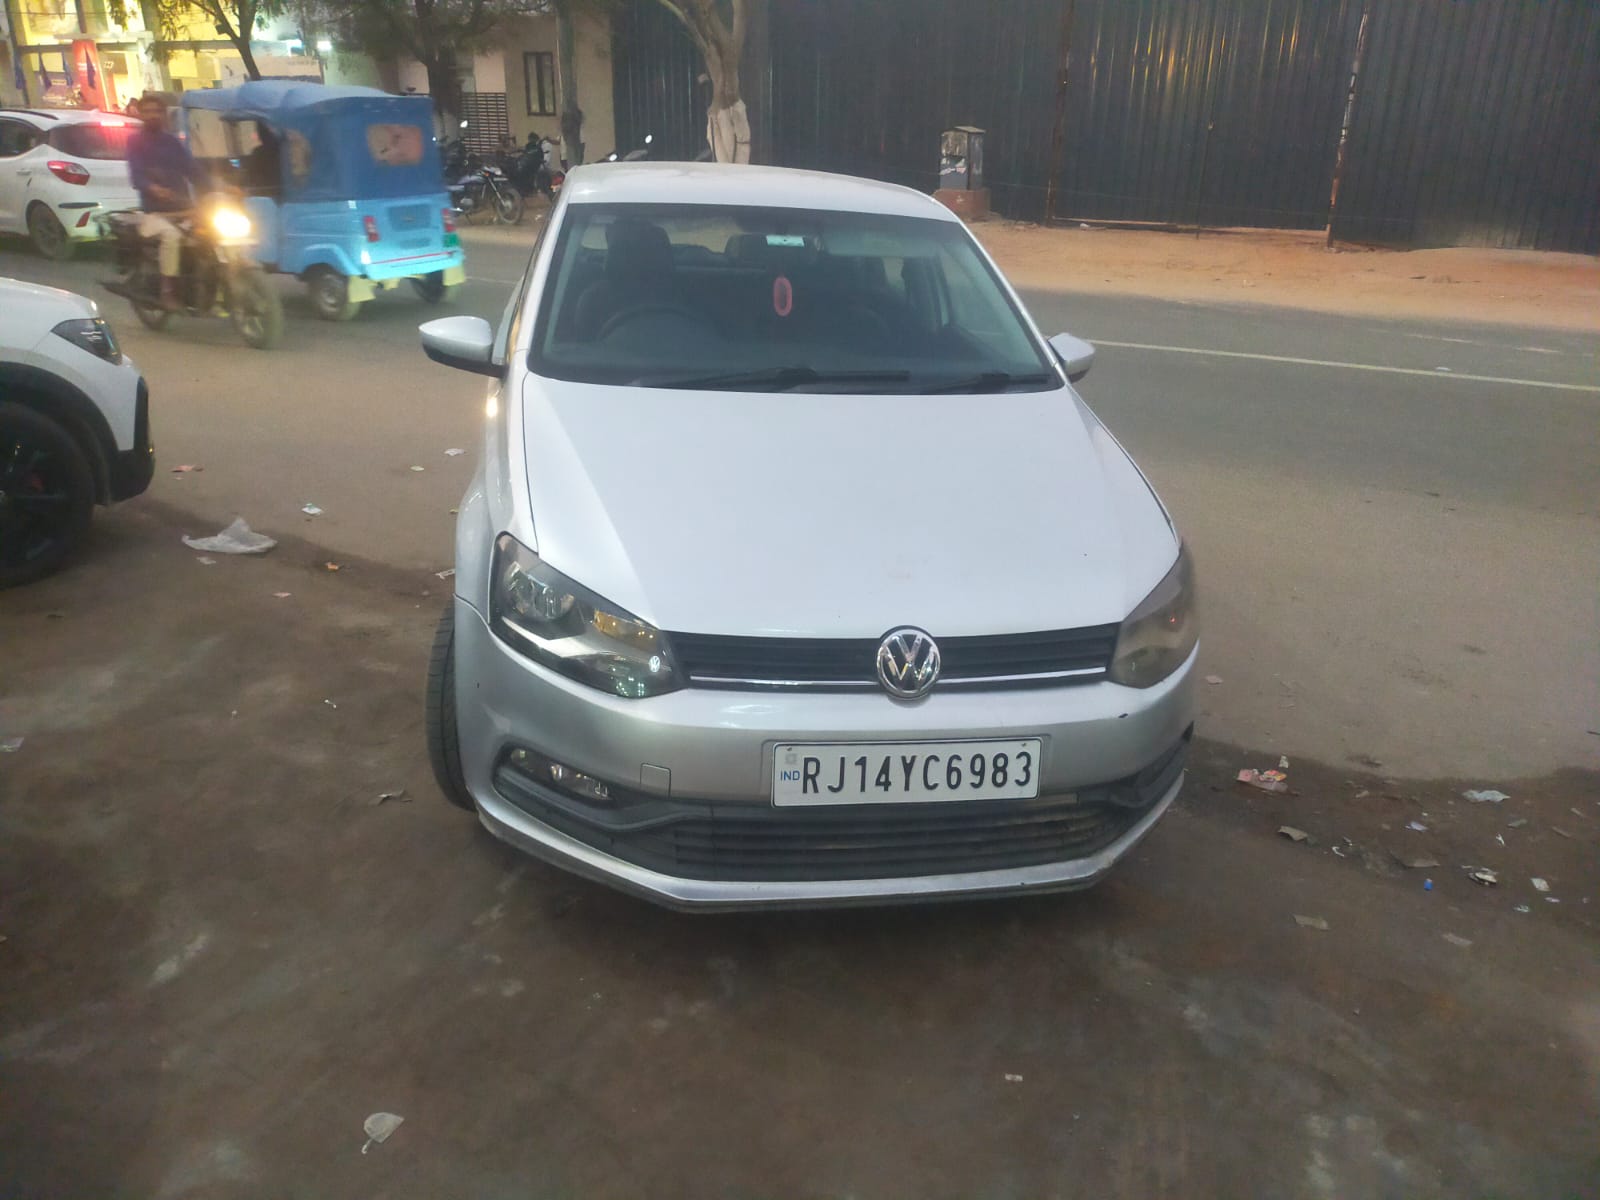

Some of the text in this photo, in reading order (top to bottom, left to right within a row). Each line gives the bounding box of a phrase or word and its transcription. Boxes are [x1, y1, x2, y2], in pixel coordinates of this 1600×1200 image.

[878, 629, 940, 696] VW
[780, 751, 1032, 794] IND RJ14YC6983
